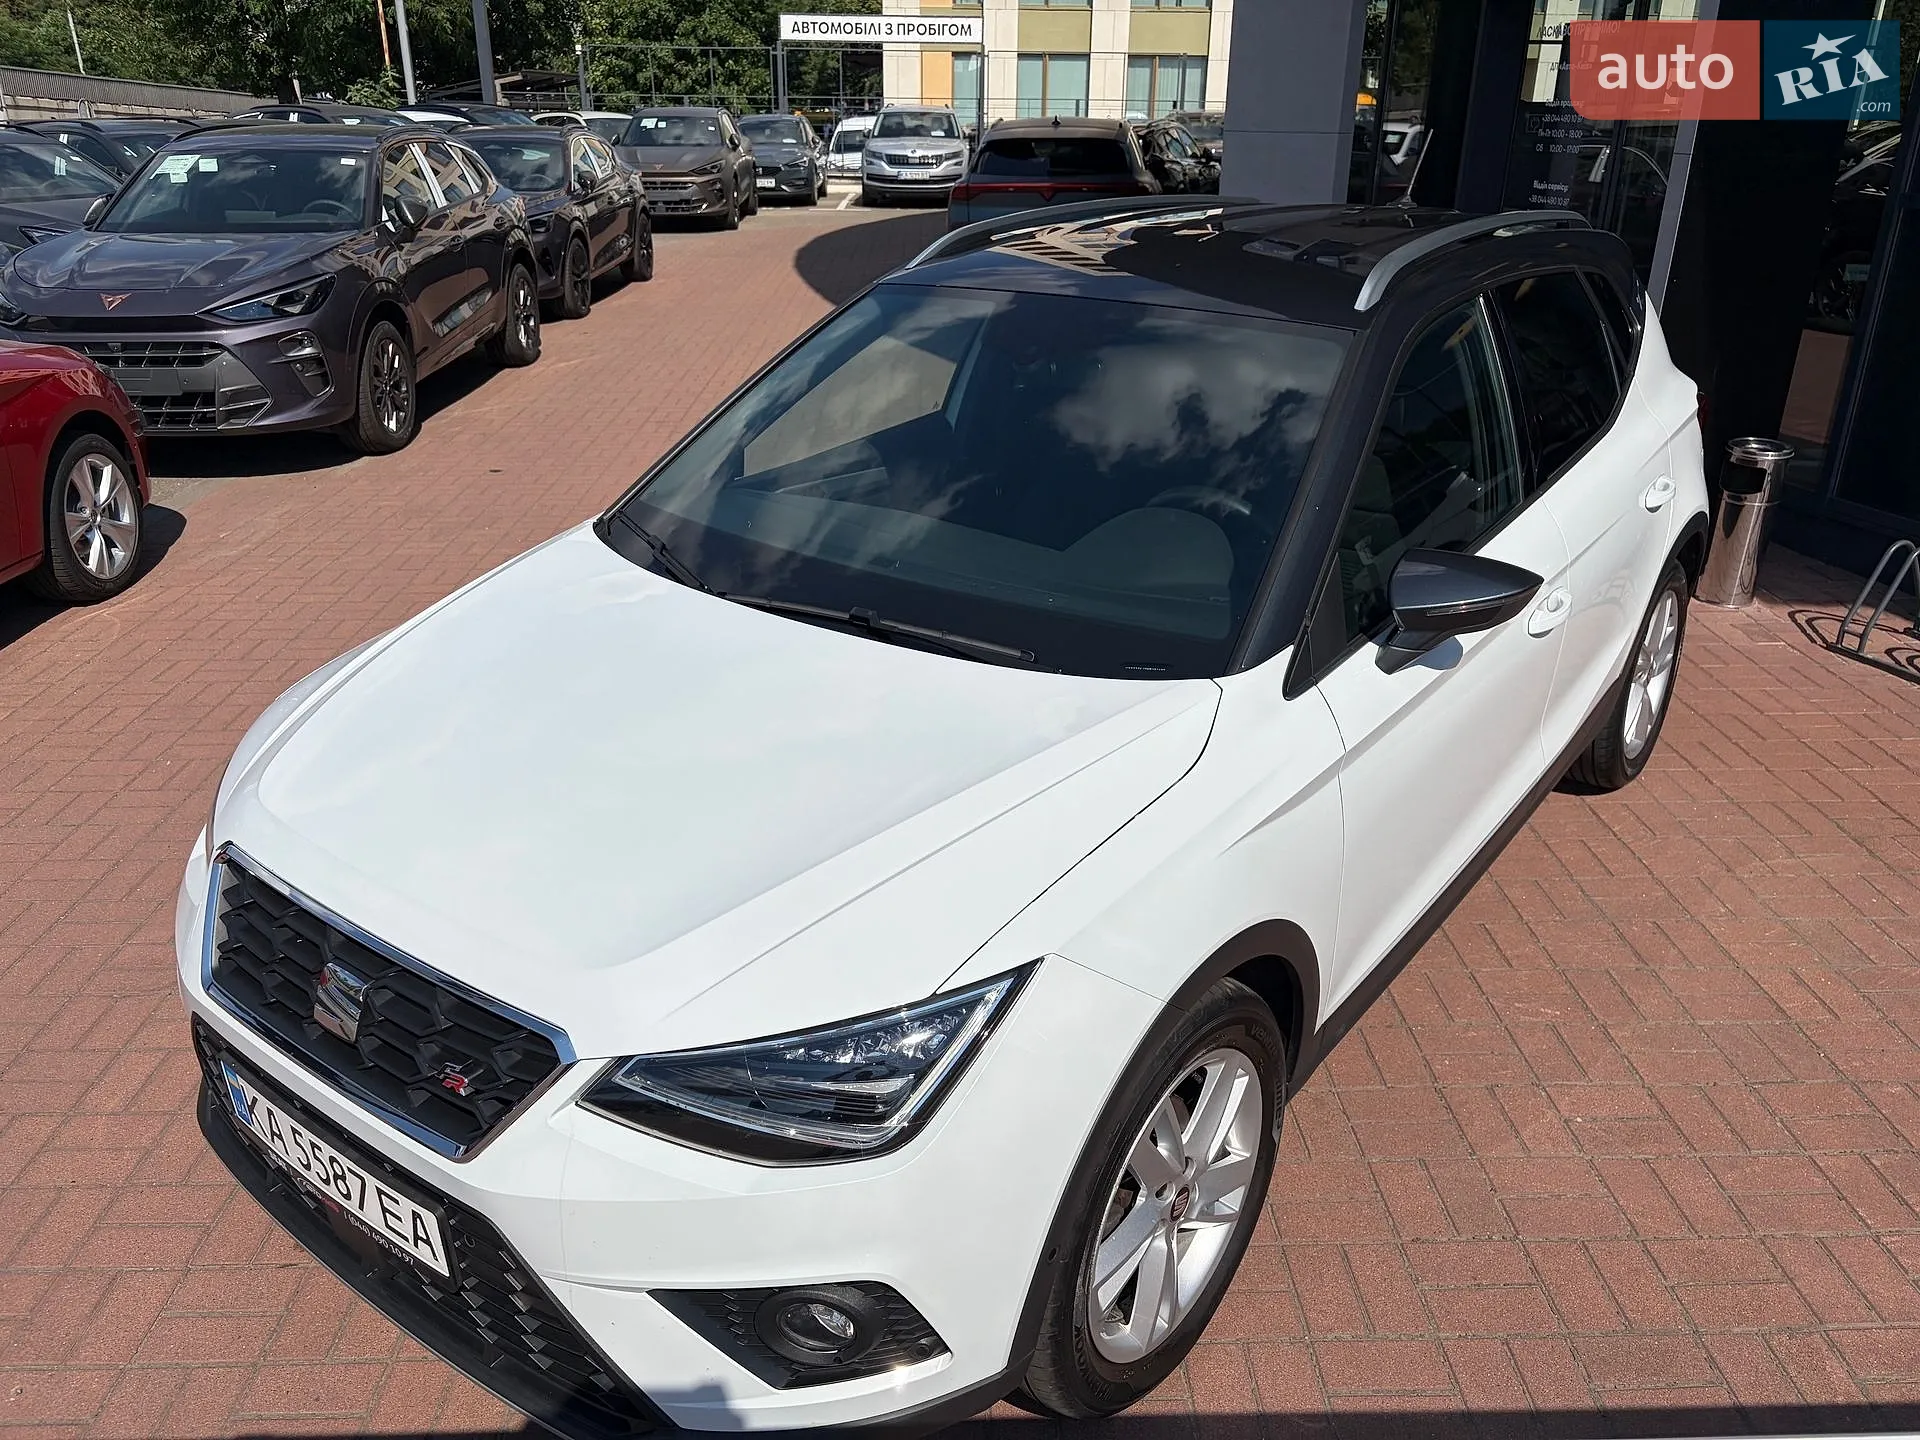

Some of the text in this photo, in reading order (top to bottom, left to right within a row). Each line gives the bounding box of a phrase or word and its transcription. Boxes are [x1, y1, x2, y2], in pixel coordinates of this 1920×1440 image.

[791, 21, 972, 37] АВТОМОБІЛІ З ПРОБІГОМ
[240, 1084, 292, 1158] KA
[289, 1123, 367, 1213] 5587
[374, 1184, 441, 1264] EA
[372, 1231, 389, 1249] 490
[389, 1244, 402, 1258] 10
[402, 1252, 415, 1266] 97
